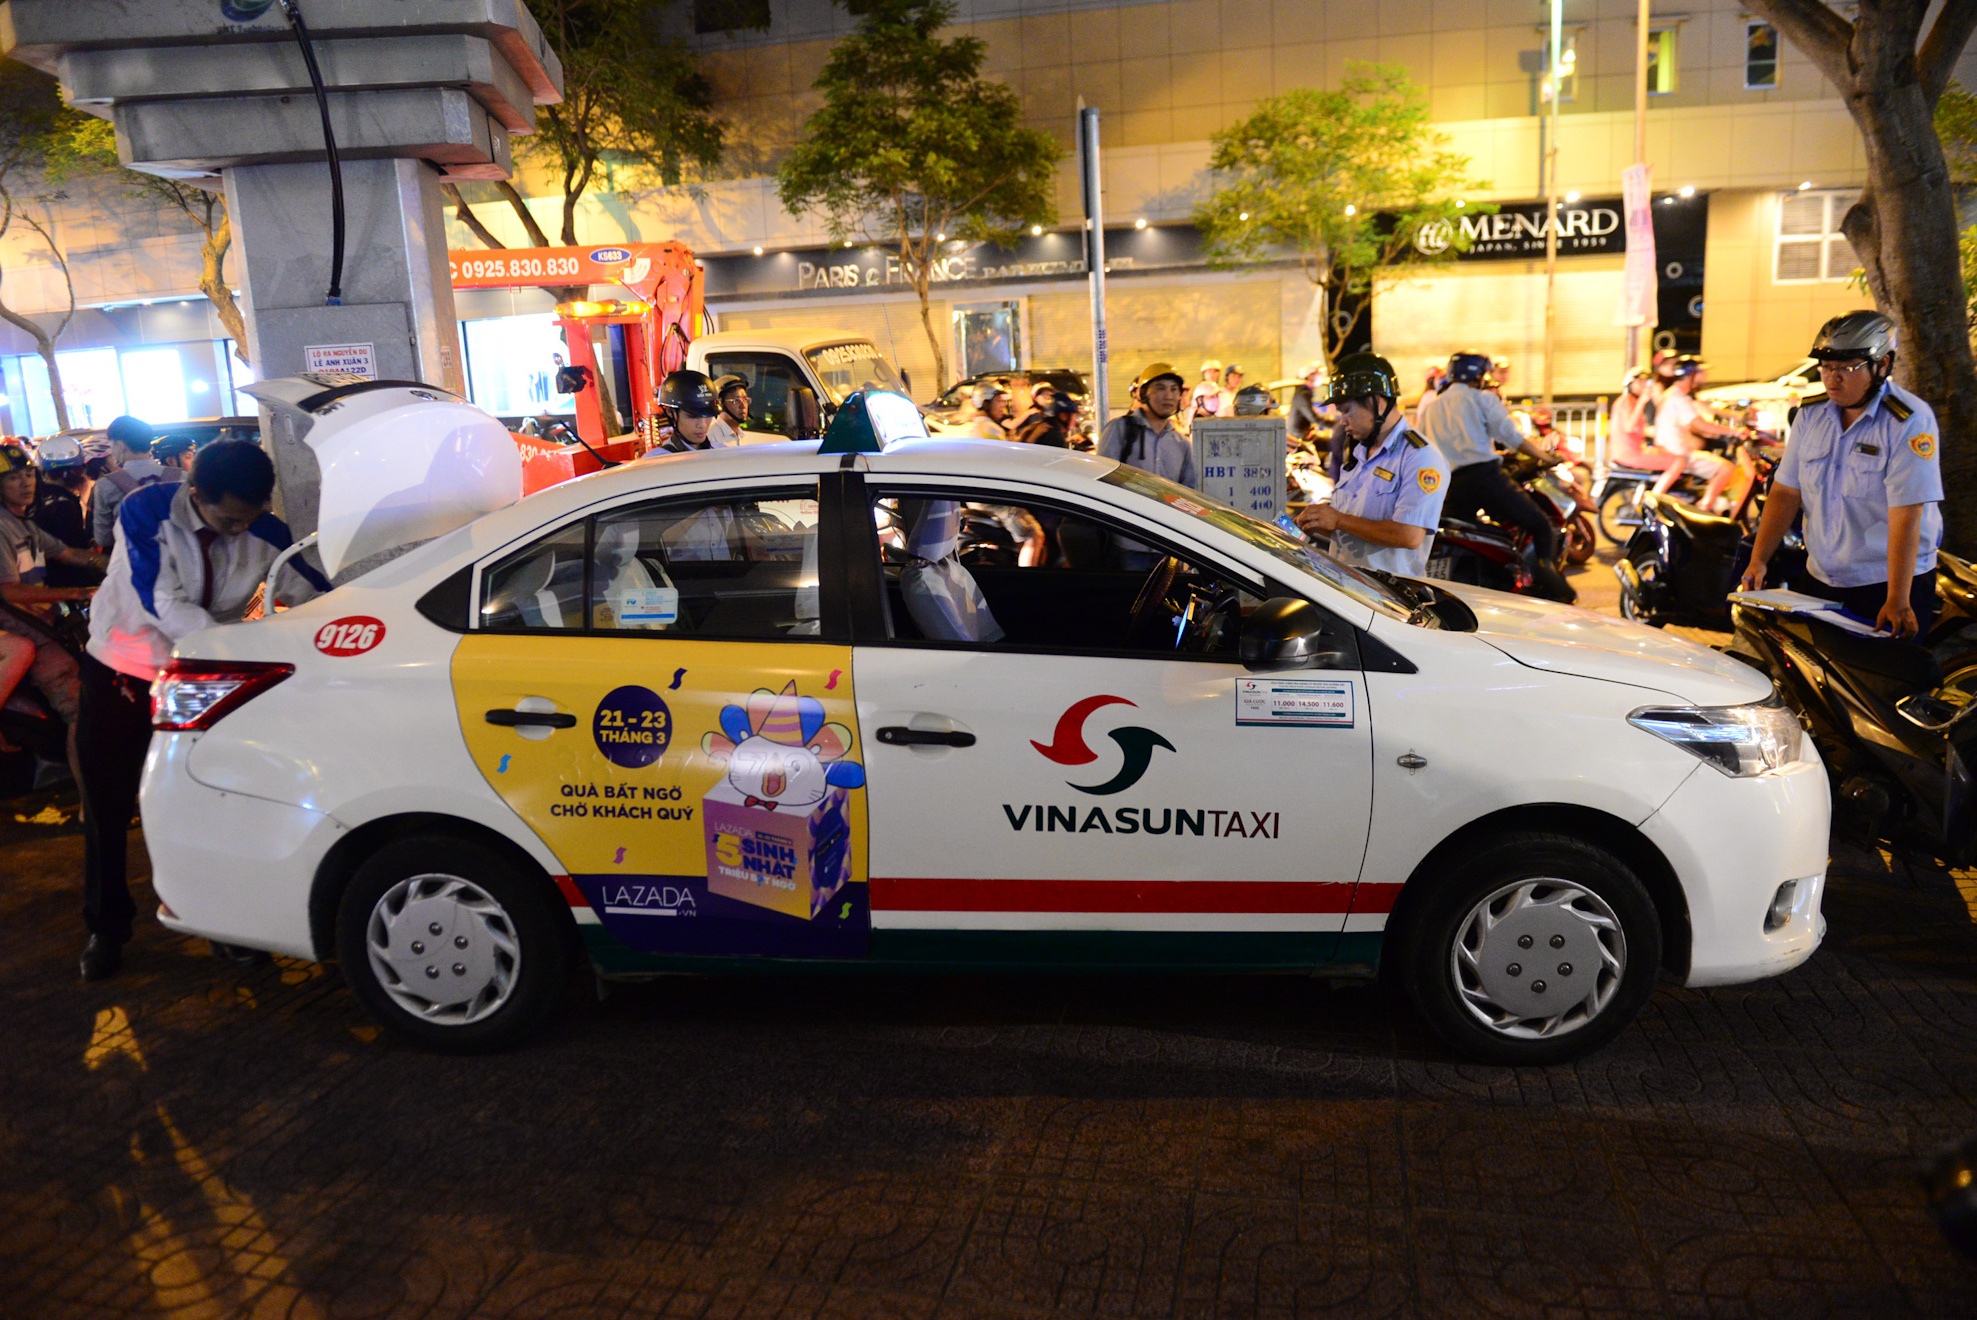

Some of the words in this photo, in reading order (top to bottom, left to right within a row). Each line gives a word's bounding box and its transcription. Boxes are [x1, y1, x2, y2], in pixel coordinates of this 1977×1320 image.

[1459, 208, 1620, 241] MENARD
[1522, 239, 1563, 250] SINE
[1572, 238, 1607, 248] 1959
[597, 250, 623, 262] KS633
[462, 257, 579, 279] 0925.830.830
[798, 262, 859, 288] PARIS
[364, 357, 369, 365] 3
[1204, 466, 1236, 478] HBT
[1249, 485, 1271, 496] 400
[316, 623, 379, 650] 9126
[600, 709, 625, 727] 21
[641, 710, 667, 729] 23
[599, 727, 654, 745] THÁNG
[656, 731, 666, 745] 3
[560, 782, 599, 798] QUÀ
[604, 782, 638, 799] BẤT
[643, 785, 683, 801] NGỜ
[550, 802, 588, 818] CHỜ
[593, 803, 652, 819] KHÁCH
[657, 805, 694, 821] QUÝ
[714, 821, 753, 837] LAZADA
[716, 831, 743, 867] 5
[742, 838, 795, 863] SINH
[750, 872, 770, 885] BT
[602, 886, 697, 908] LAZADA
